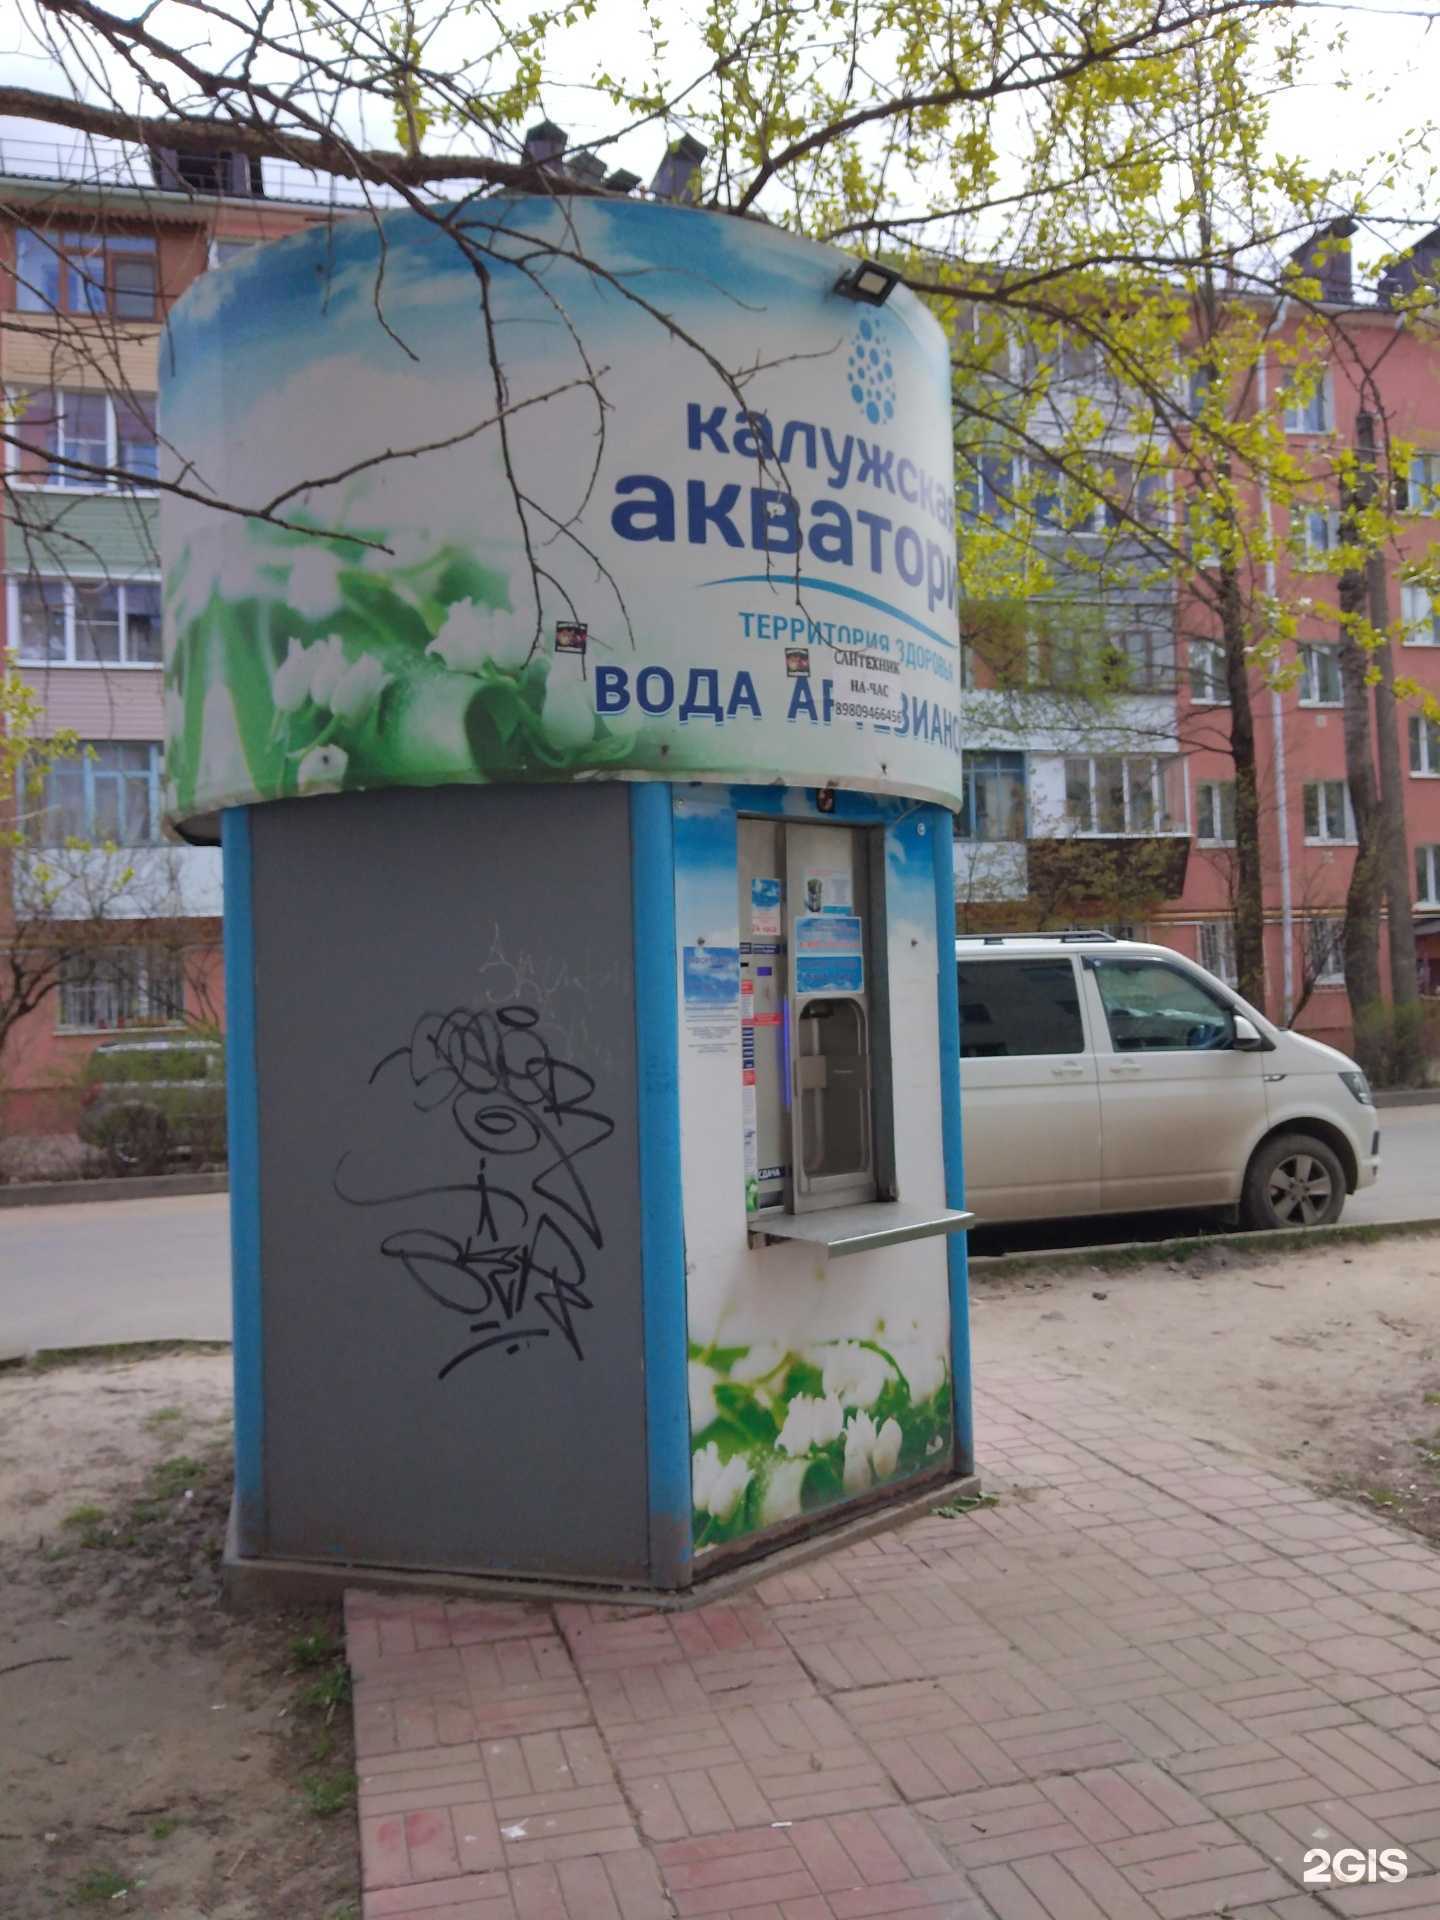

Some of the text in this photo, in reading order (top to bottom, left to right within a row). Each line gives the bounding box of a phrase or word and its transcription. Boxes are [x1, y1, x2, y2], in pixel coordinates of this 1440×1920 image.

[739, 611, 889, 653] ТЕРРИТОРИЯ
[834, 650, 901, 675] САНТЕХНИК
[595, 665, 762, 723] ВОДА
